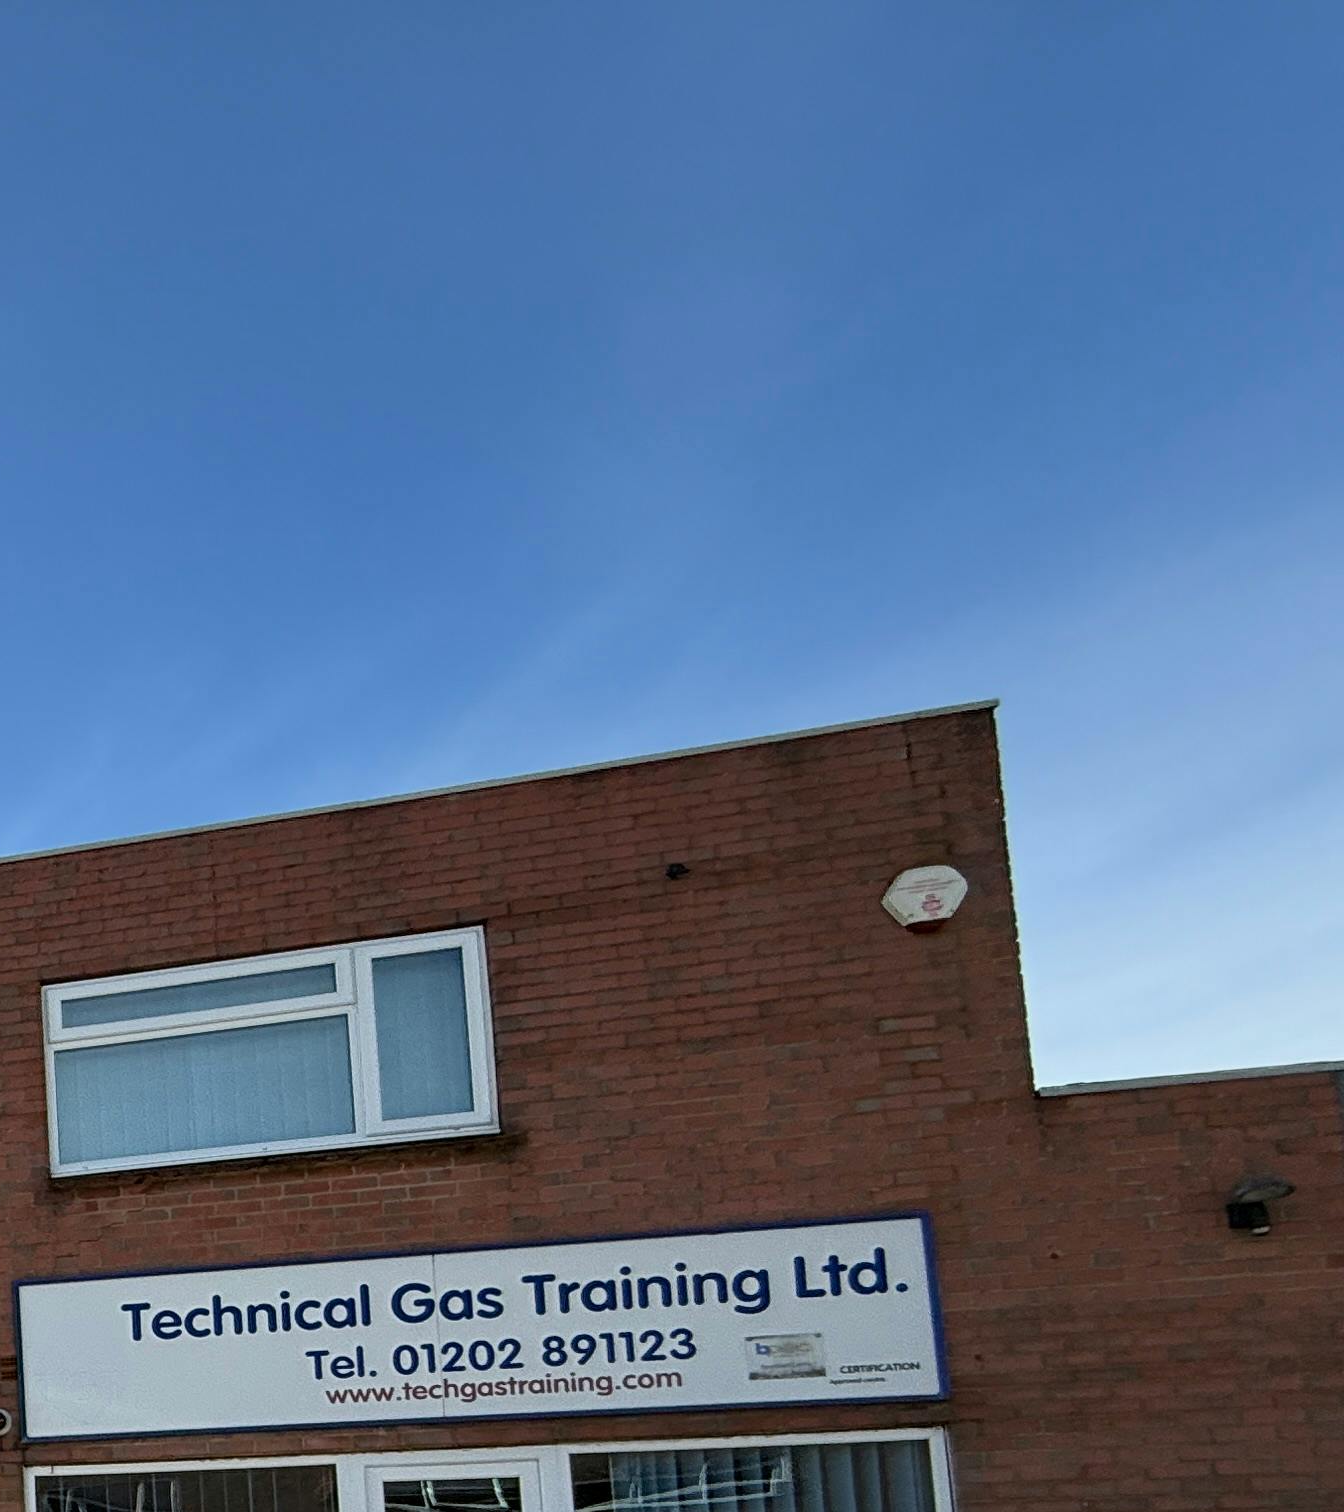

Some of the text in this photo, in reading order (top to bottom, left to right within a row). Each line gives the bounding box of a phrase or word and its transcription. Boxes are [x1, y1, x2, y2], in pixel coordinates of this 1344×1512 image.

[121, 1246, 909, 1342] Technical Gas Training Ltd.
[305, 1328, 698, 1381] Tel. 01202 891123
[839, 1361, 921, 1375] CERTIFICATION
[325, 1371, 683, 1405] www.techgastraining.com
